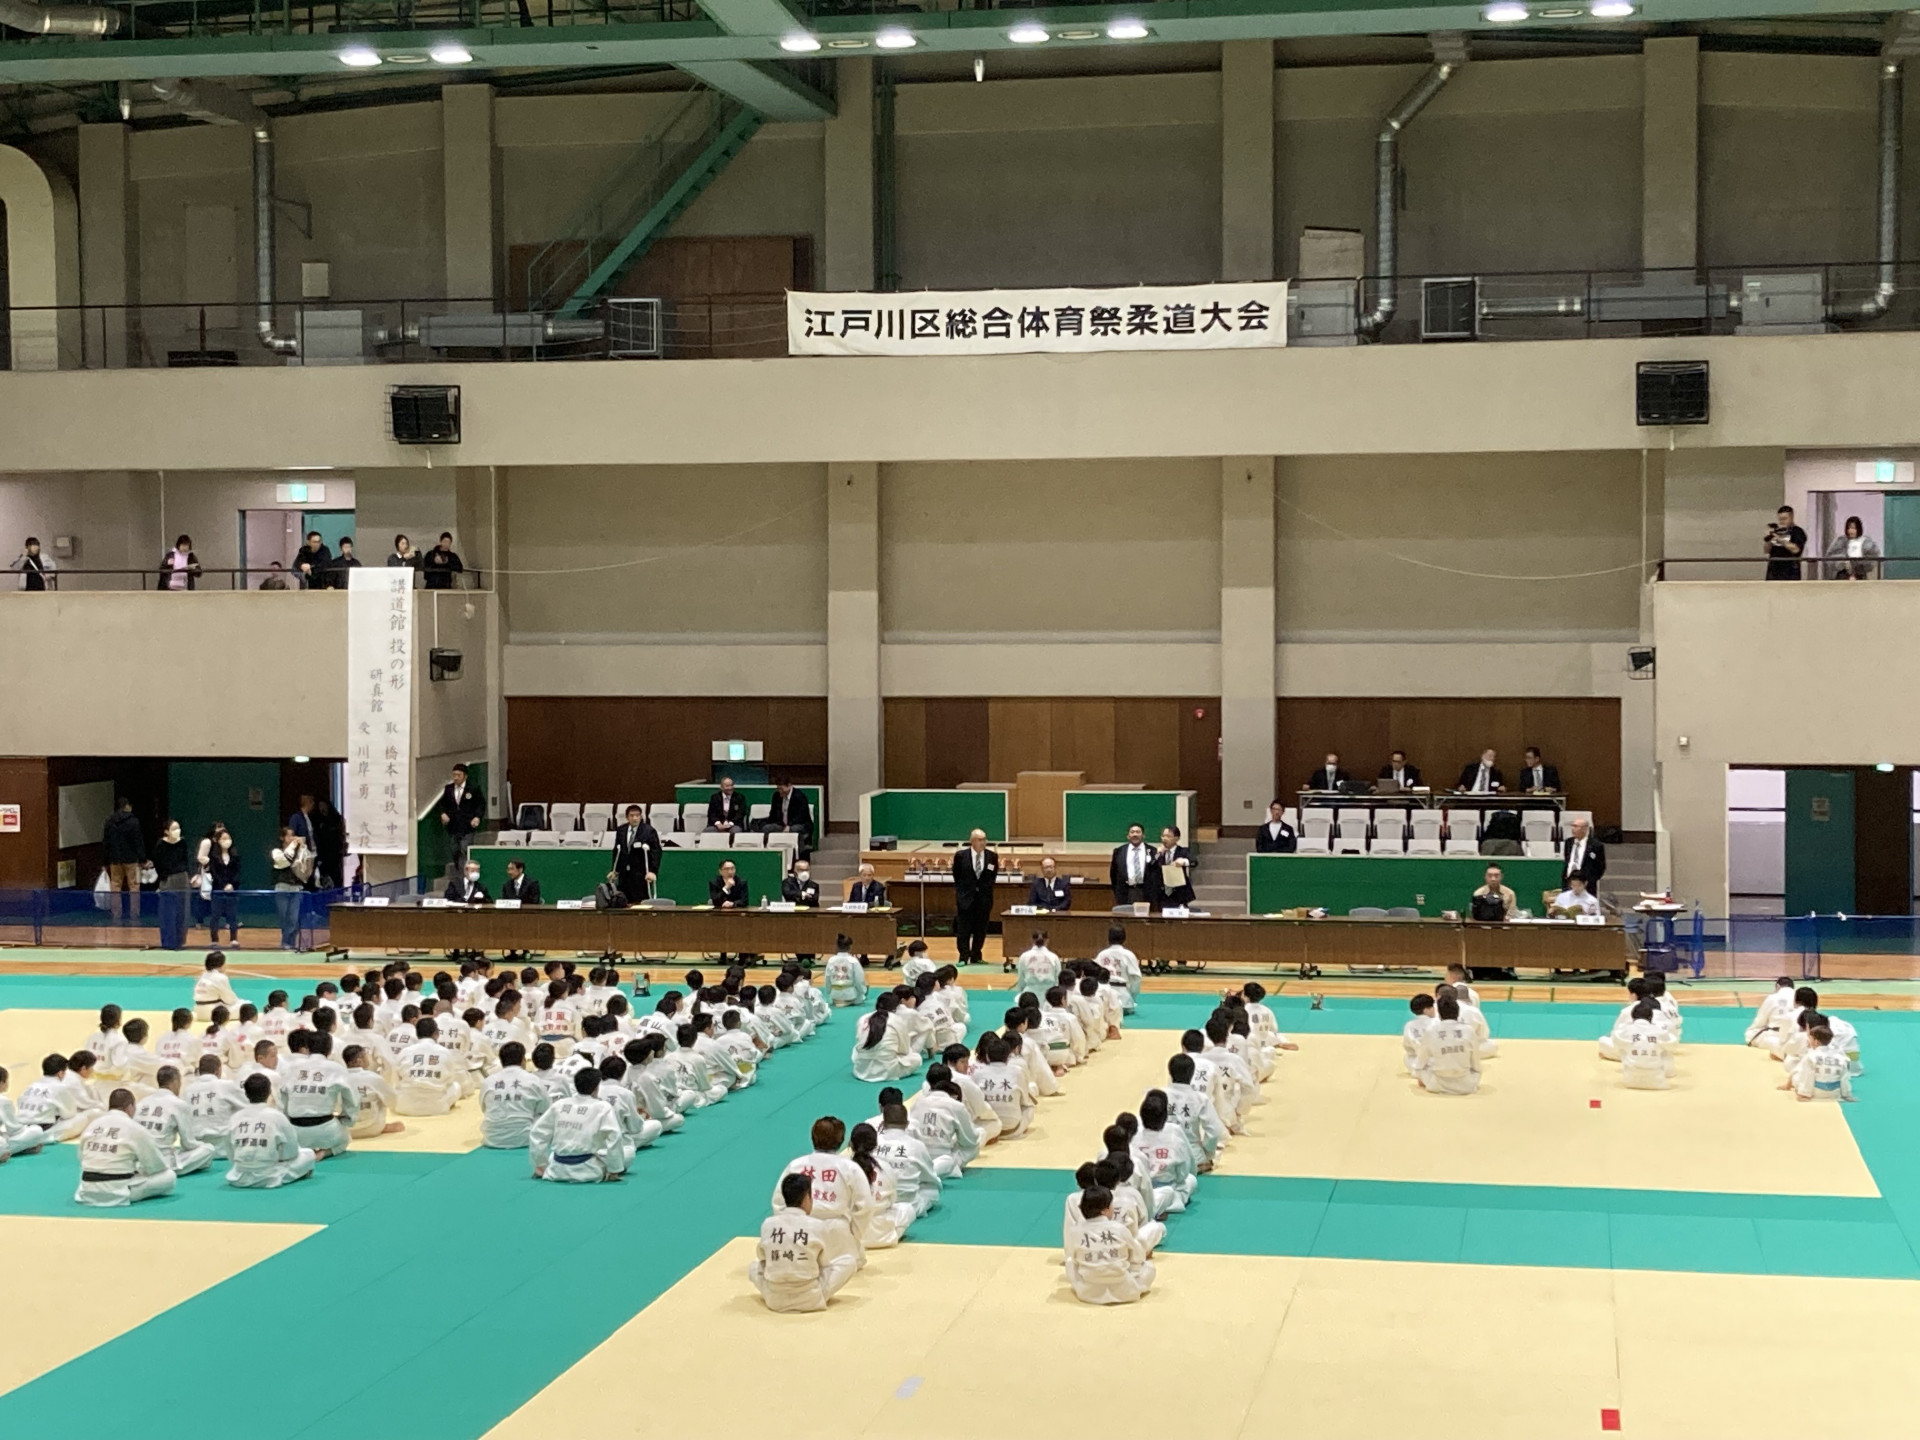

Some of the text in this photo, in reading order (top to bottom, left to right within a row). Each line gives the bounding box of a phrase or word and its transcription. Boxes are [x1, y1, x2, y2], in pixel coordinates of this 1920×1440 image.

[804, 300, 1271, 340] 江戸川区総合体育祭柔道大会
[980, 1078, 1013, 1091] 鈴木
[238, 1121, 267, 1135] 竹内
[770, 1227, 809, 1246] 竹内
[1080, 1230, 1118, 1249] 小林
